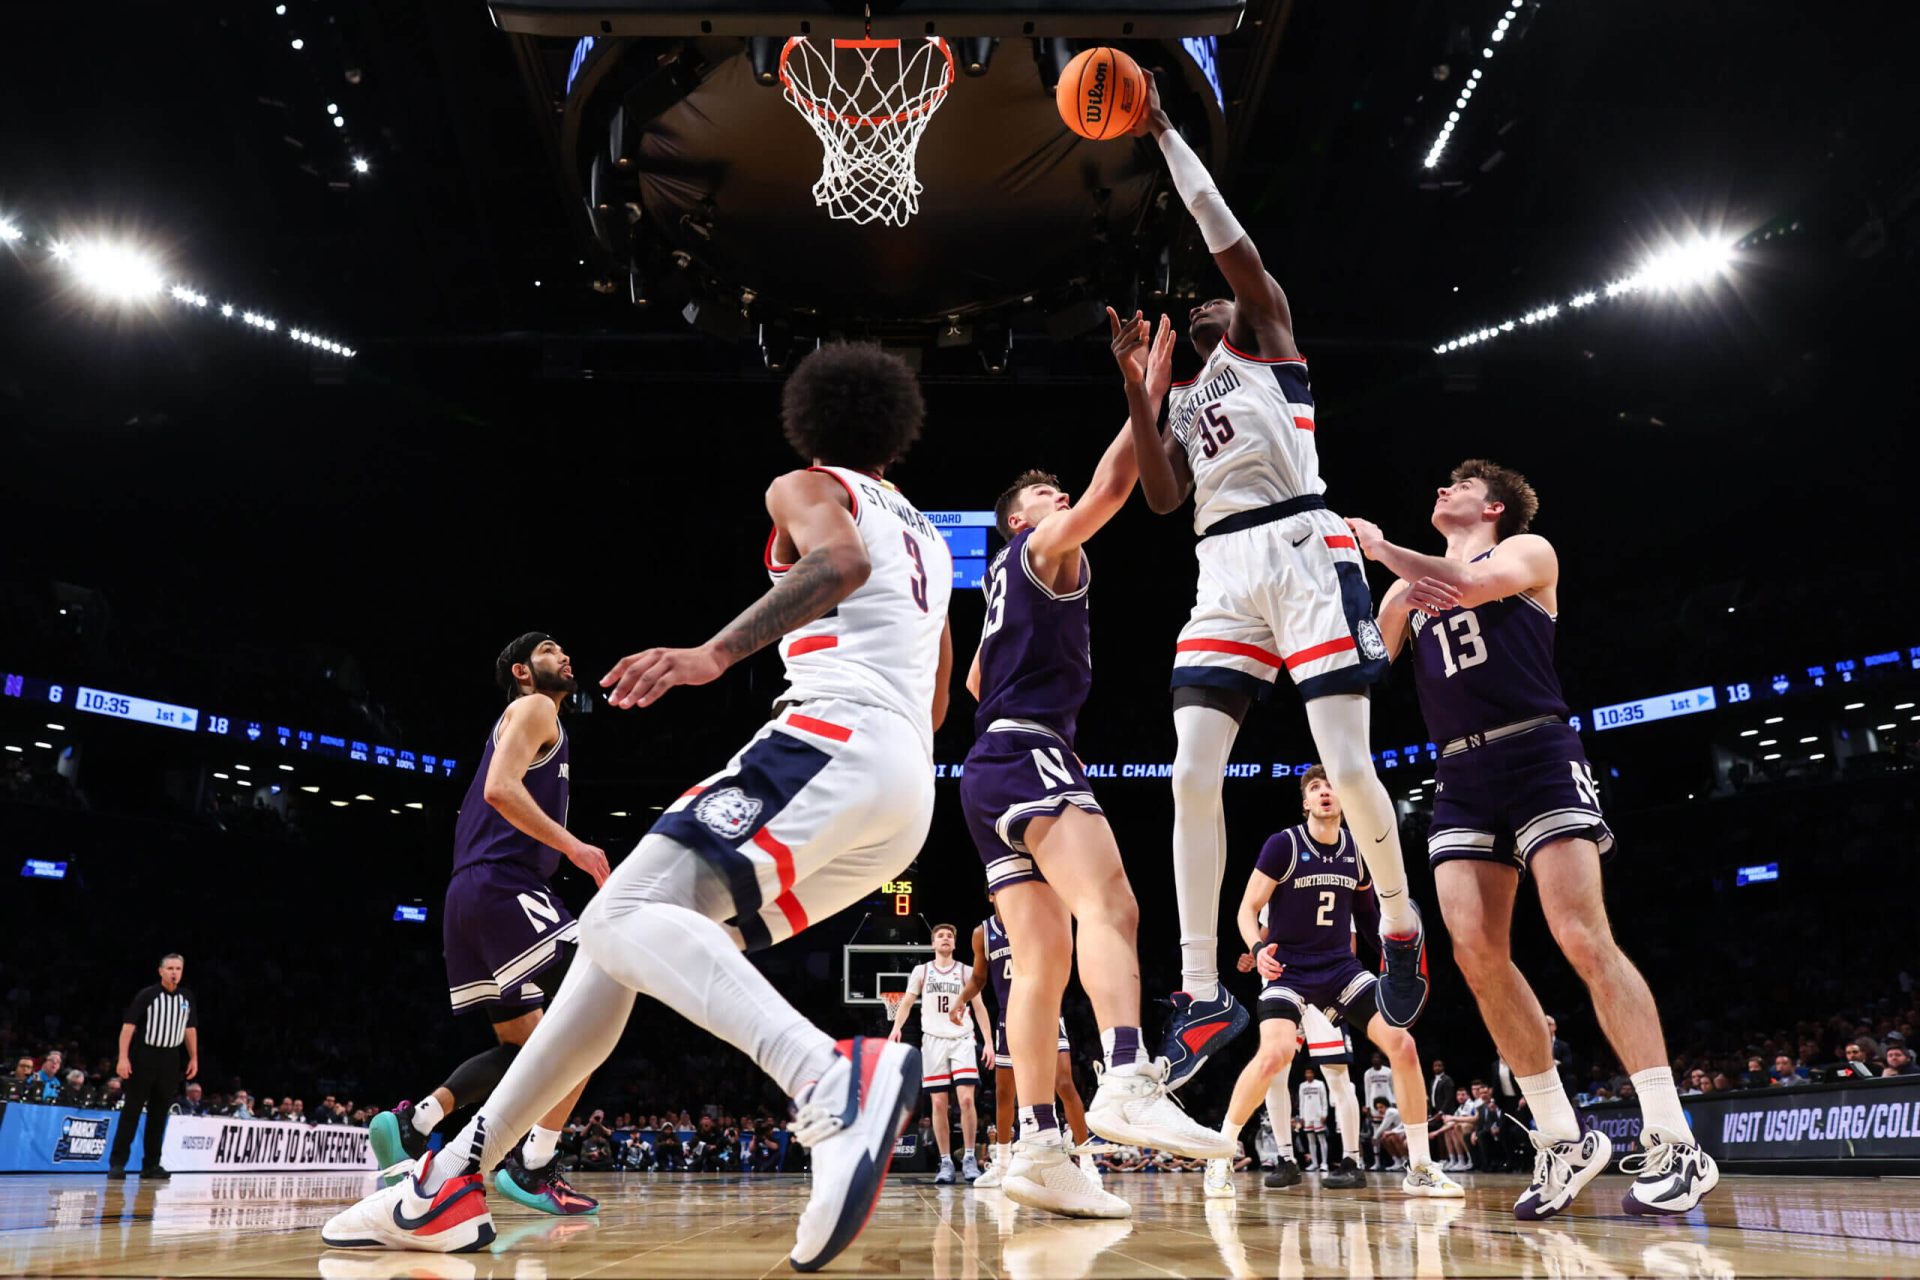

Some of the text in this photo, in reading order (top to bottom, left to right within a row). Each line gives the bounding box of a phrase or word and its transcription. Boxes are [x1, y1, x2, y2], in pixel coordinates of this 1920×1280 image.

[1086, 62, 1108, 123] Wilson
[1199, 402, 1235, 459] 35
[860, 483, 935, 541] STWART
[924, 514, 962, 524] BOARD
[903, 530, 928, 613] 3
[1432, 610, 1488, 679] 13
[49, 685, 63, 703] 6
[83, 692, 131, 715] 10:35
[156, 708, 175, 722] 1st
[208, 716, 229, 734] 18
[1599, 705, 1645, 726] 10:35
[1670, 698, 1690, 711] 1st
[1726, 683, 1751, 703] 18
[1030, 747, 1075, 790] N
[881, 881, 912, 894] 10:35
[1294, 873, 1358, 891] NORTHWESTERN
[516, 890, 561, 934] N
[896, 894, 909, 915] 8
[1317, 891, 1335, 926] 2
[926, 982, 961, 996] CONNECTICUT
[937, 995, 949, 1013] 12
[205, 1136, 214, 1150] BY
[215, 1125, 283, 1164] ATLANTIC
[284, 1128, 300, 1163] 10
[300, 1129, 370, 1164] CONFERENCE
[1723, 1111, 1764, 1143] VISIT
